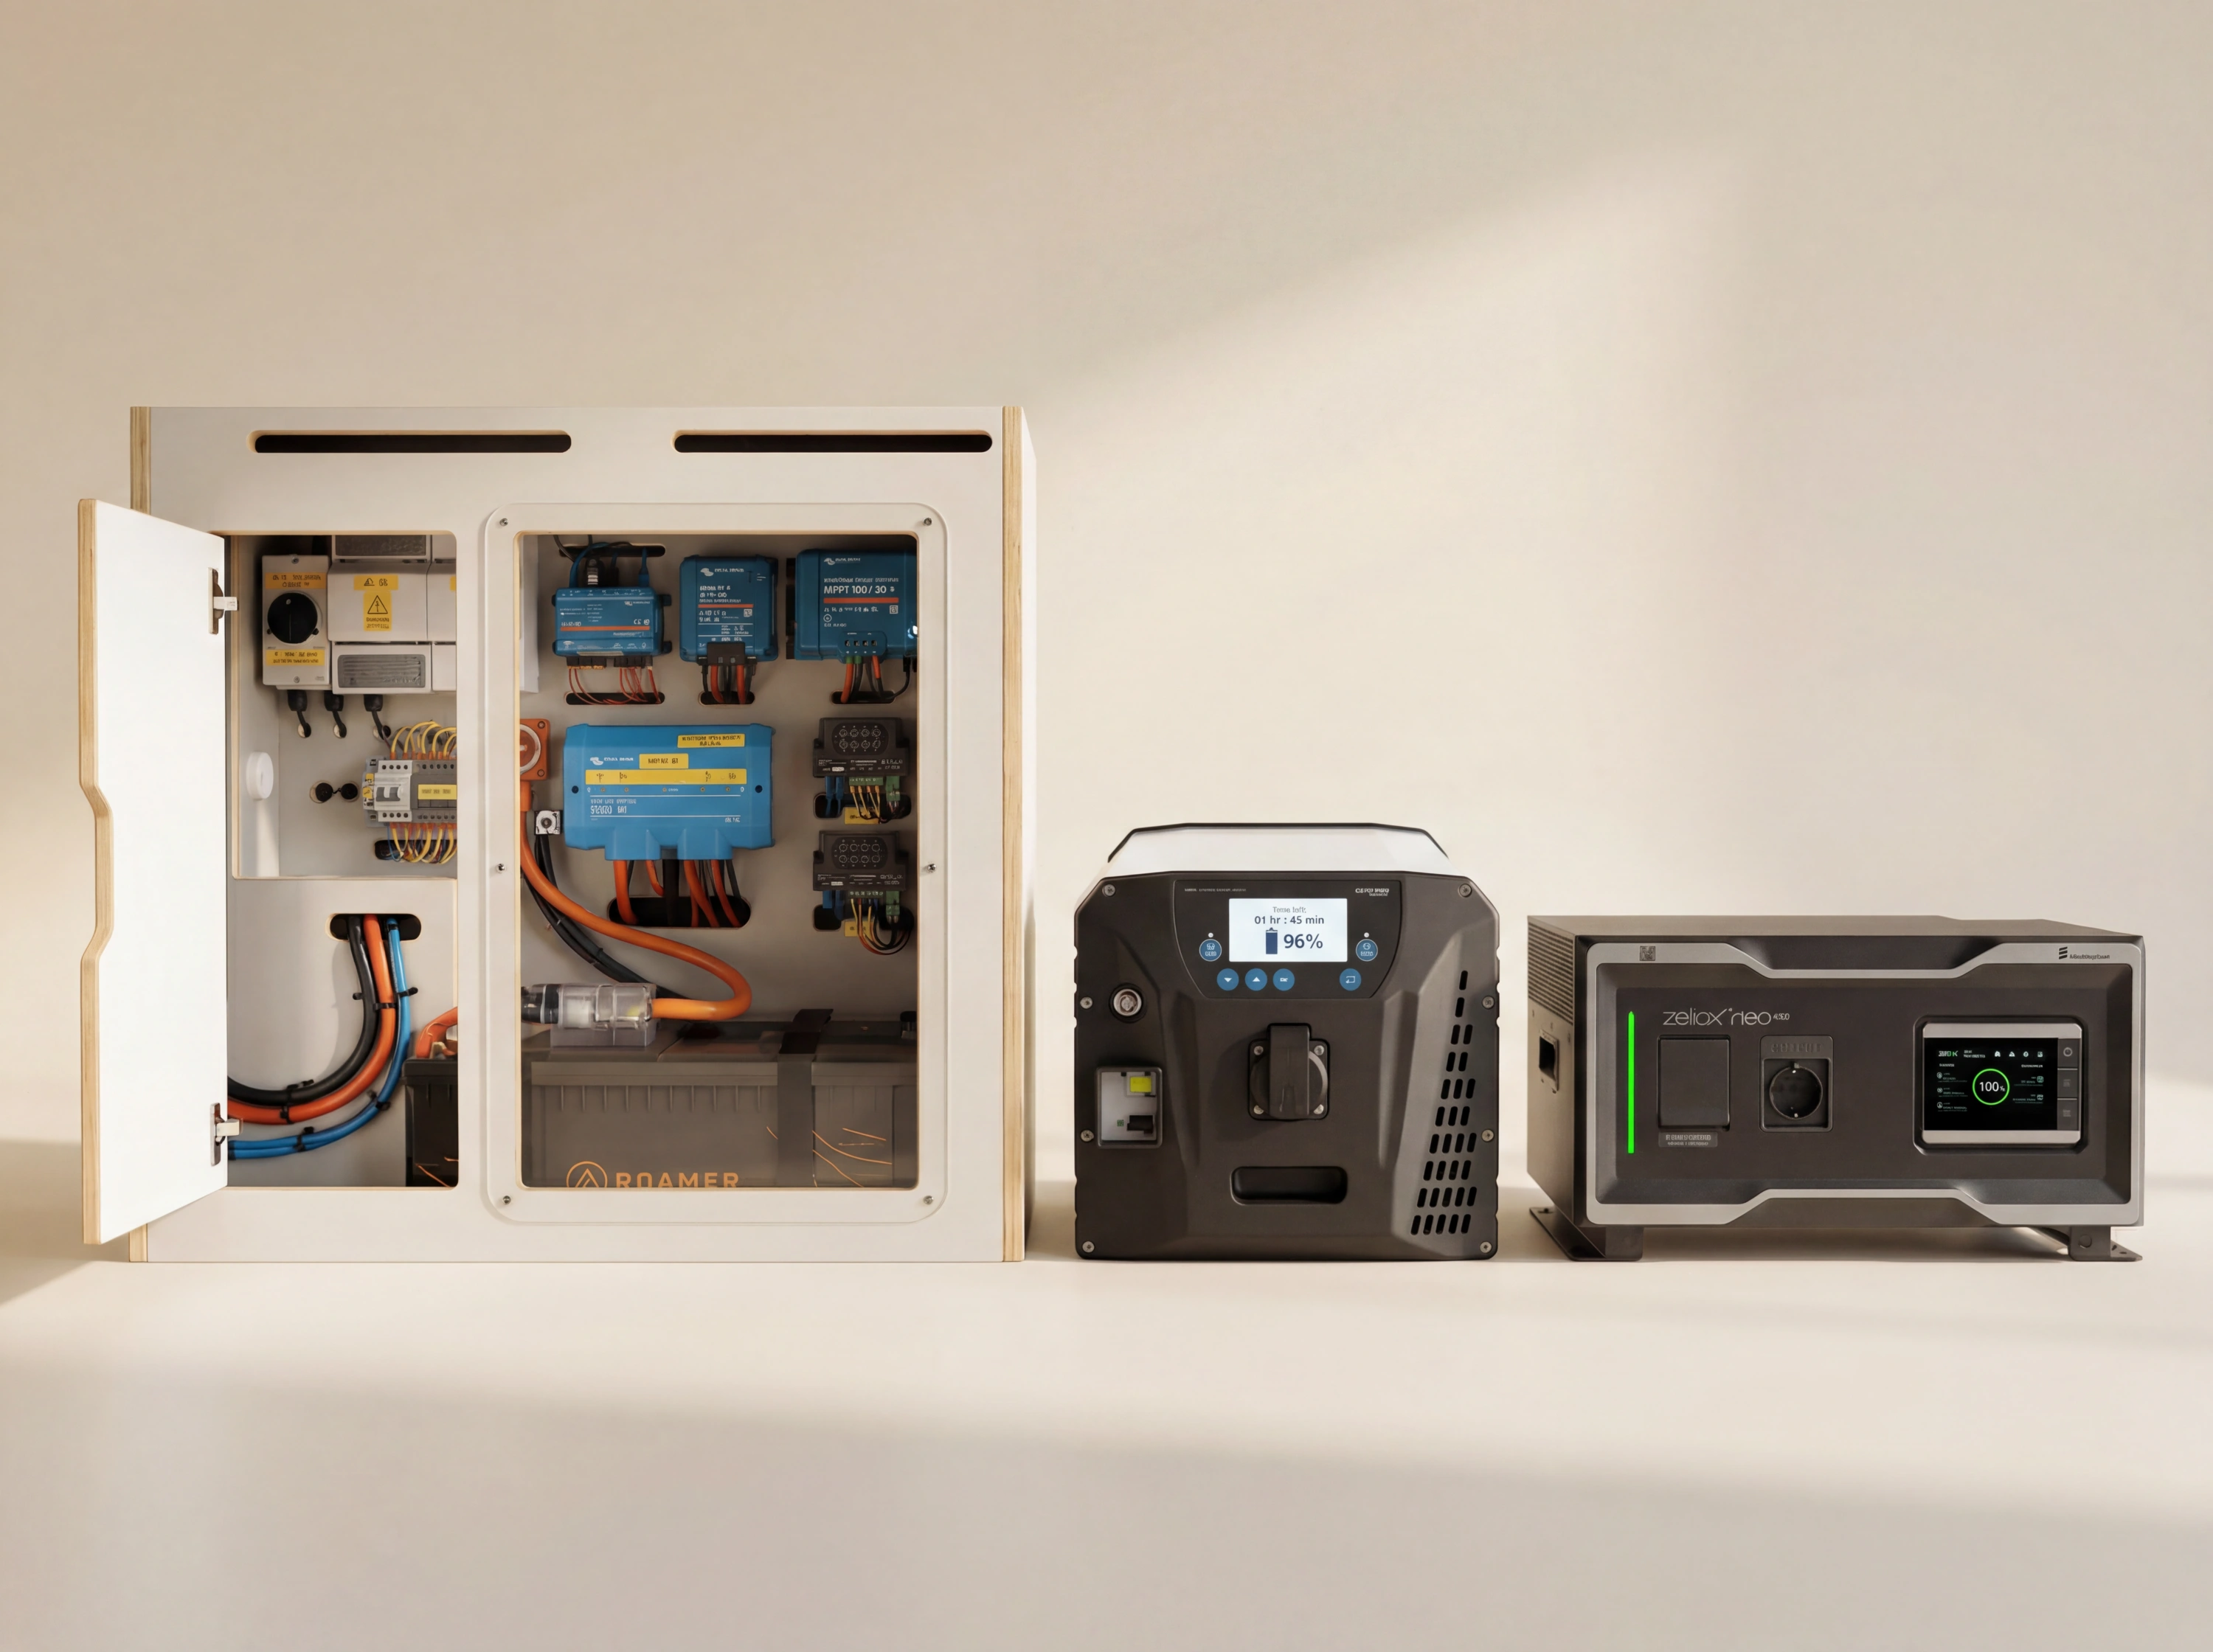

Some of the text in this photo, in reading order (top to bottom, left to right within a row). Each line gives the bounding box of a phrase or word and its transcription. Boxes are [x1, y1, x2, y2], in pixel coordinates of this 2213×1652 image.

[824, 586, 849, 594] MPPT
[1254, 915, 1266, 924] 01
[1270, 915, 1281, 924] hr
[1289, 915, 1302, 924] 45
[1305, 914, 1325, 924] min
[1284, 934, 1323, 949] 96%
[616, 1172, 739, 1187] ROAMER
